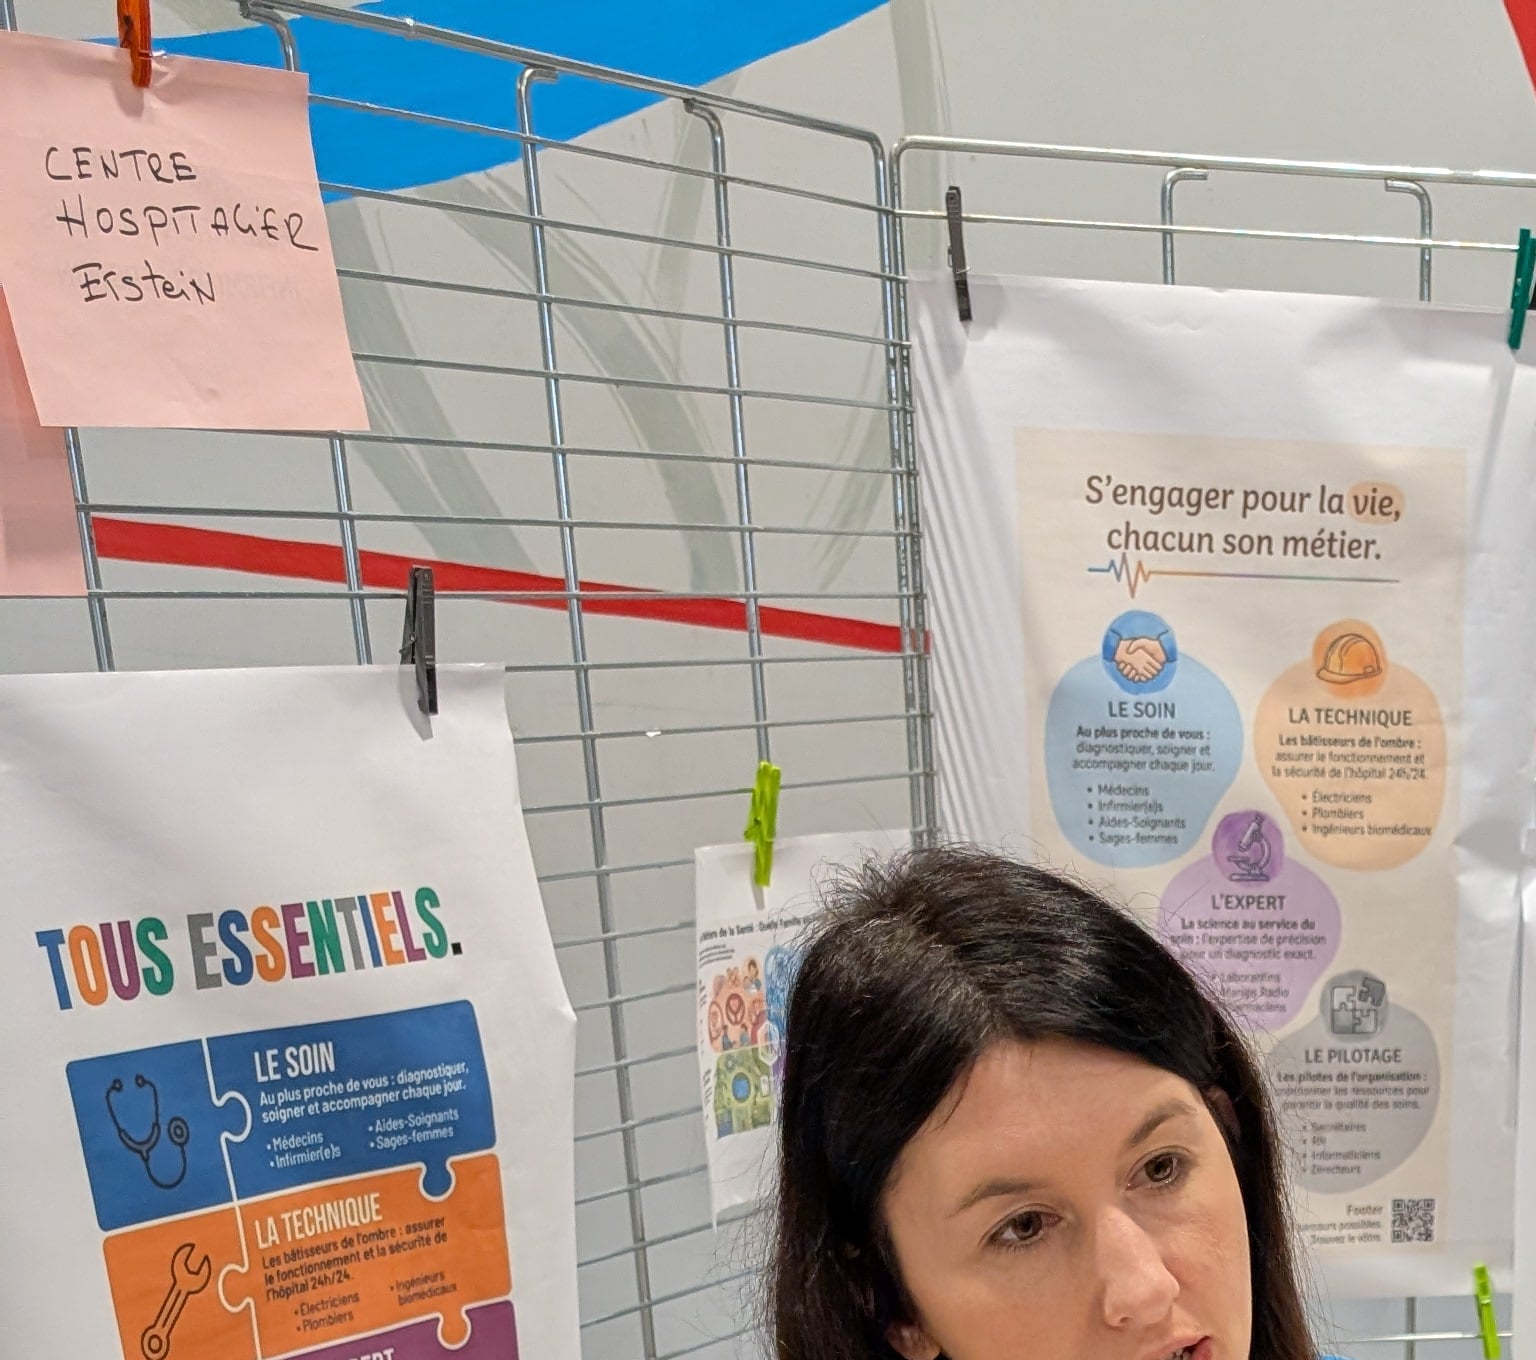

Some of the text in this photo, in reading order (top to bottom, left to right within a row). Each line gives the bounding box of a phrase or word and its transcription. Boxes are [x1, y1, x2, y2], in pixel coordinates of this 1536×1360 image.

[45, 145, 197, 183] CENTRE
[1085, 474, 1401, 521] S'engager pour la vie,
[1106, 522, 1381, 560] chacun son métier.
[1108, 701, 1176, 718] LE SOIN
[1289, 708, 1413, 728] LA TECHNIQUE
[1211, 895, 1286, 911] L'EXPERT
[35, 886, 463, 1010] TOUS ESSENTIELS.
[254, 1041, 336, 1083] LE SOIN
[1305, 1049, 1402, 1063] LE PILOTAGE
[259, 1061, 469, 1107] Au plus proche de vous diagnostiquer,
[262, 1078, 467, 1124] soigner et accompagner chaque jour.
[375, 1108, 459, 1132] Aides-Soignants
[377, 1126, 454, 1150] Sages-femmes
[272, 1131, 323, 1152] Médecins
[275, 1144, 341, 1169] Infirmier(e)s
[255, 1193, 383, 1249] LA TECHNIQUE
[262, 1217, 445, 1269] Les bâtisseurs de l'ombre assurer
[264, 1232, 448, 1286] le fonctionnement et la sécurité de
